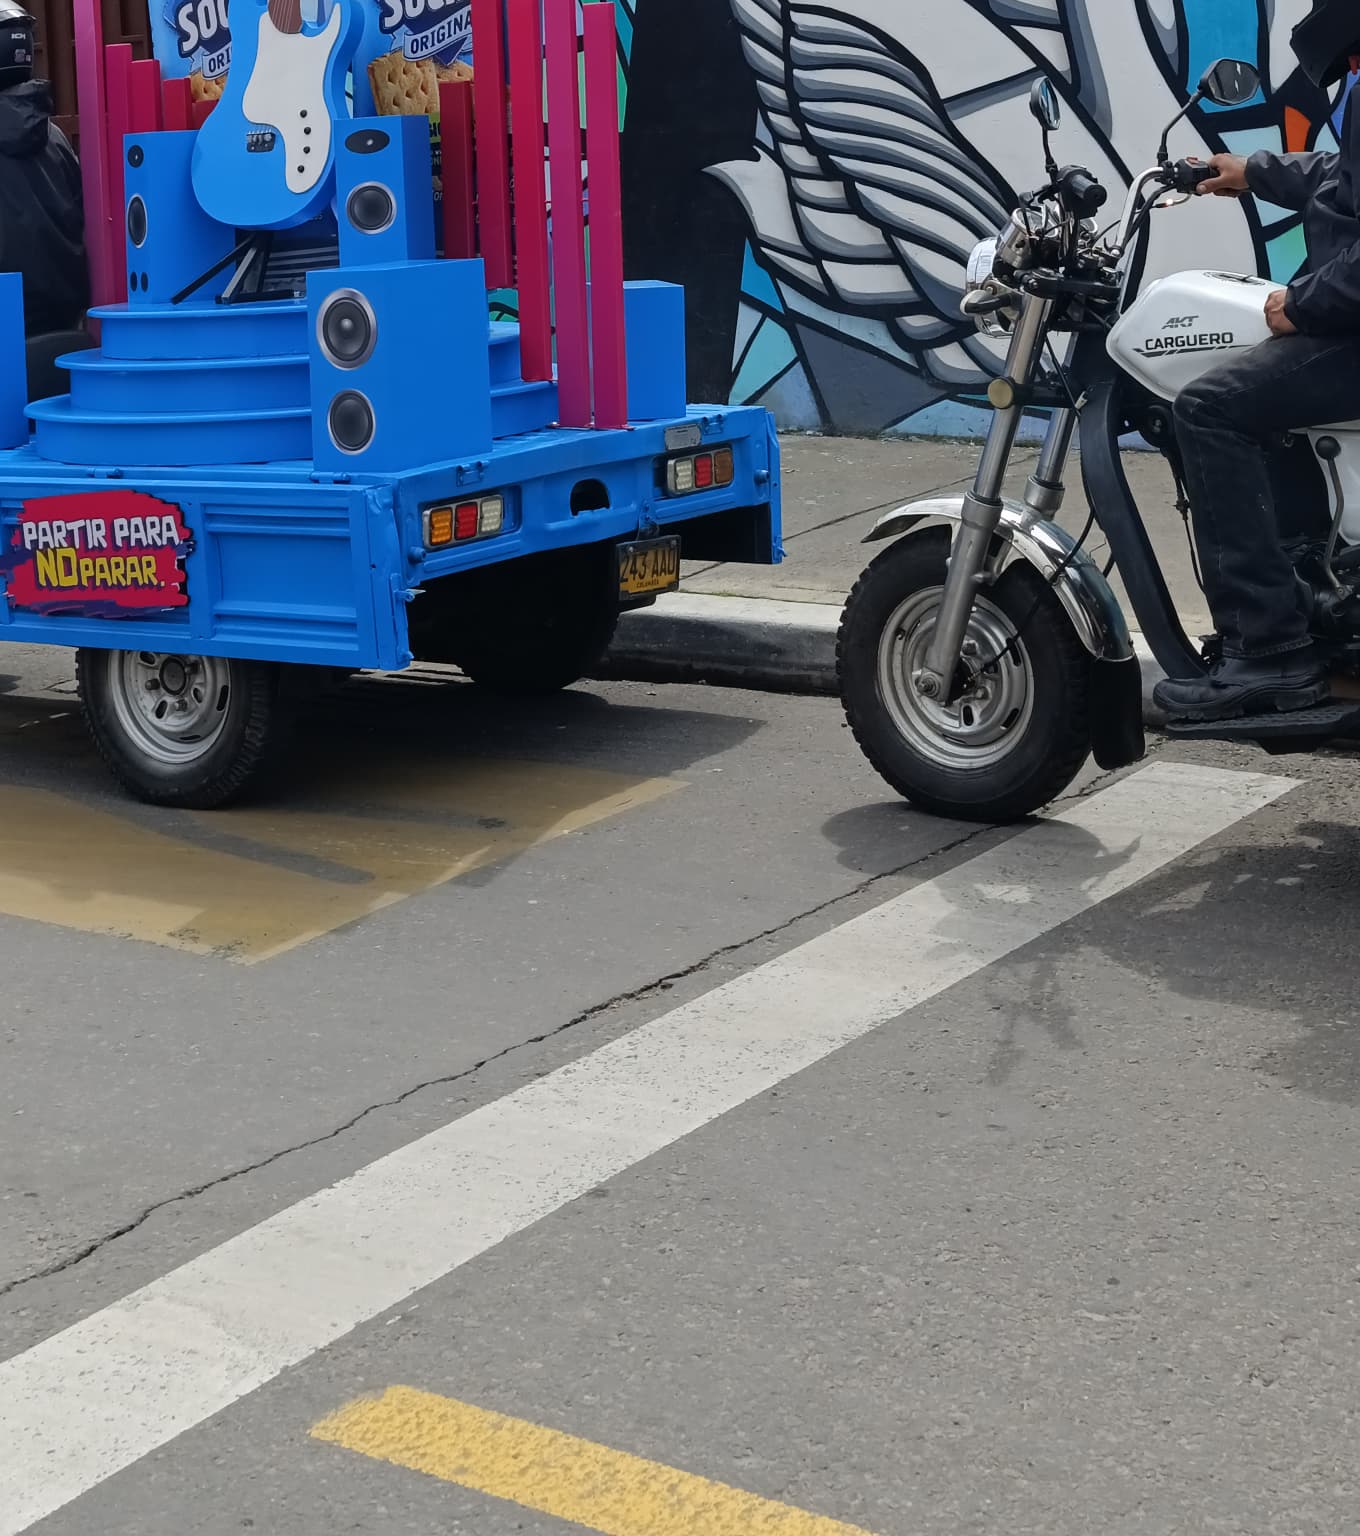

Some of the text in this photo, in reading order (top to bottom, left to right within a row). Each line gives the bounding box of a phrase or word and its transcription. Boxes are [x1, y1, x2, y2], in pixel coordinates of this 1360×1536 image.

[410, 14, 472, 55] ORIGINA
[1161, 315, 1199, 330] AKT
[1145, 332, 1234, 351] CARGUERO
[22, 515, 180, 550] PARTIR PARA
[36, 547, 166, 587] NO PARAR.
[621, 552, 648, 583] 243
